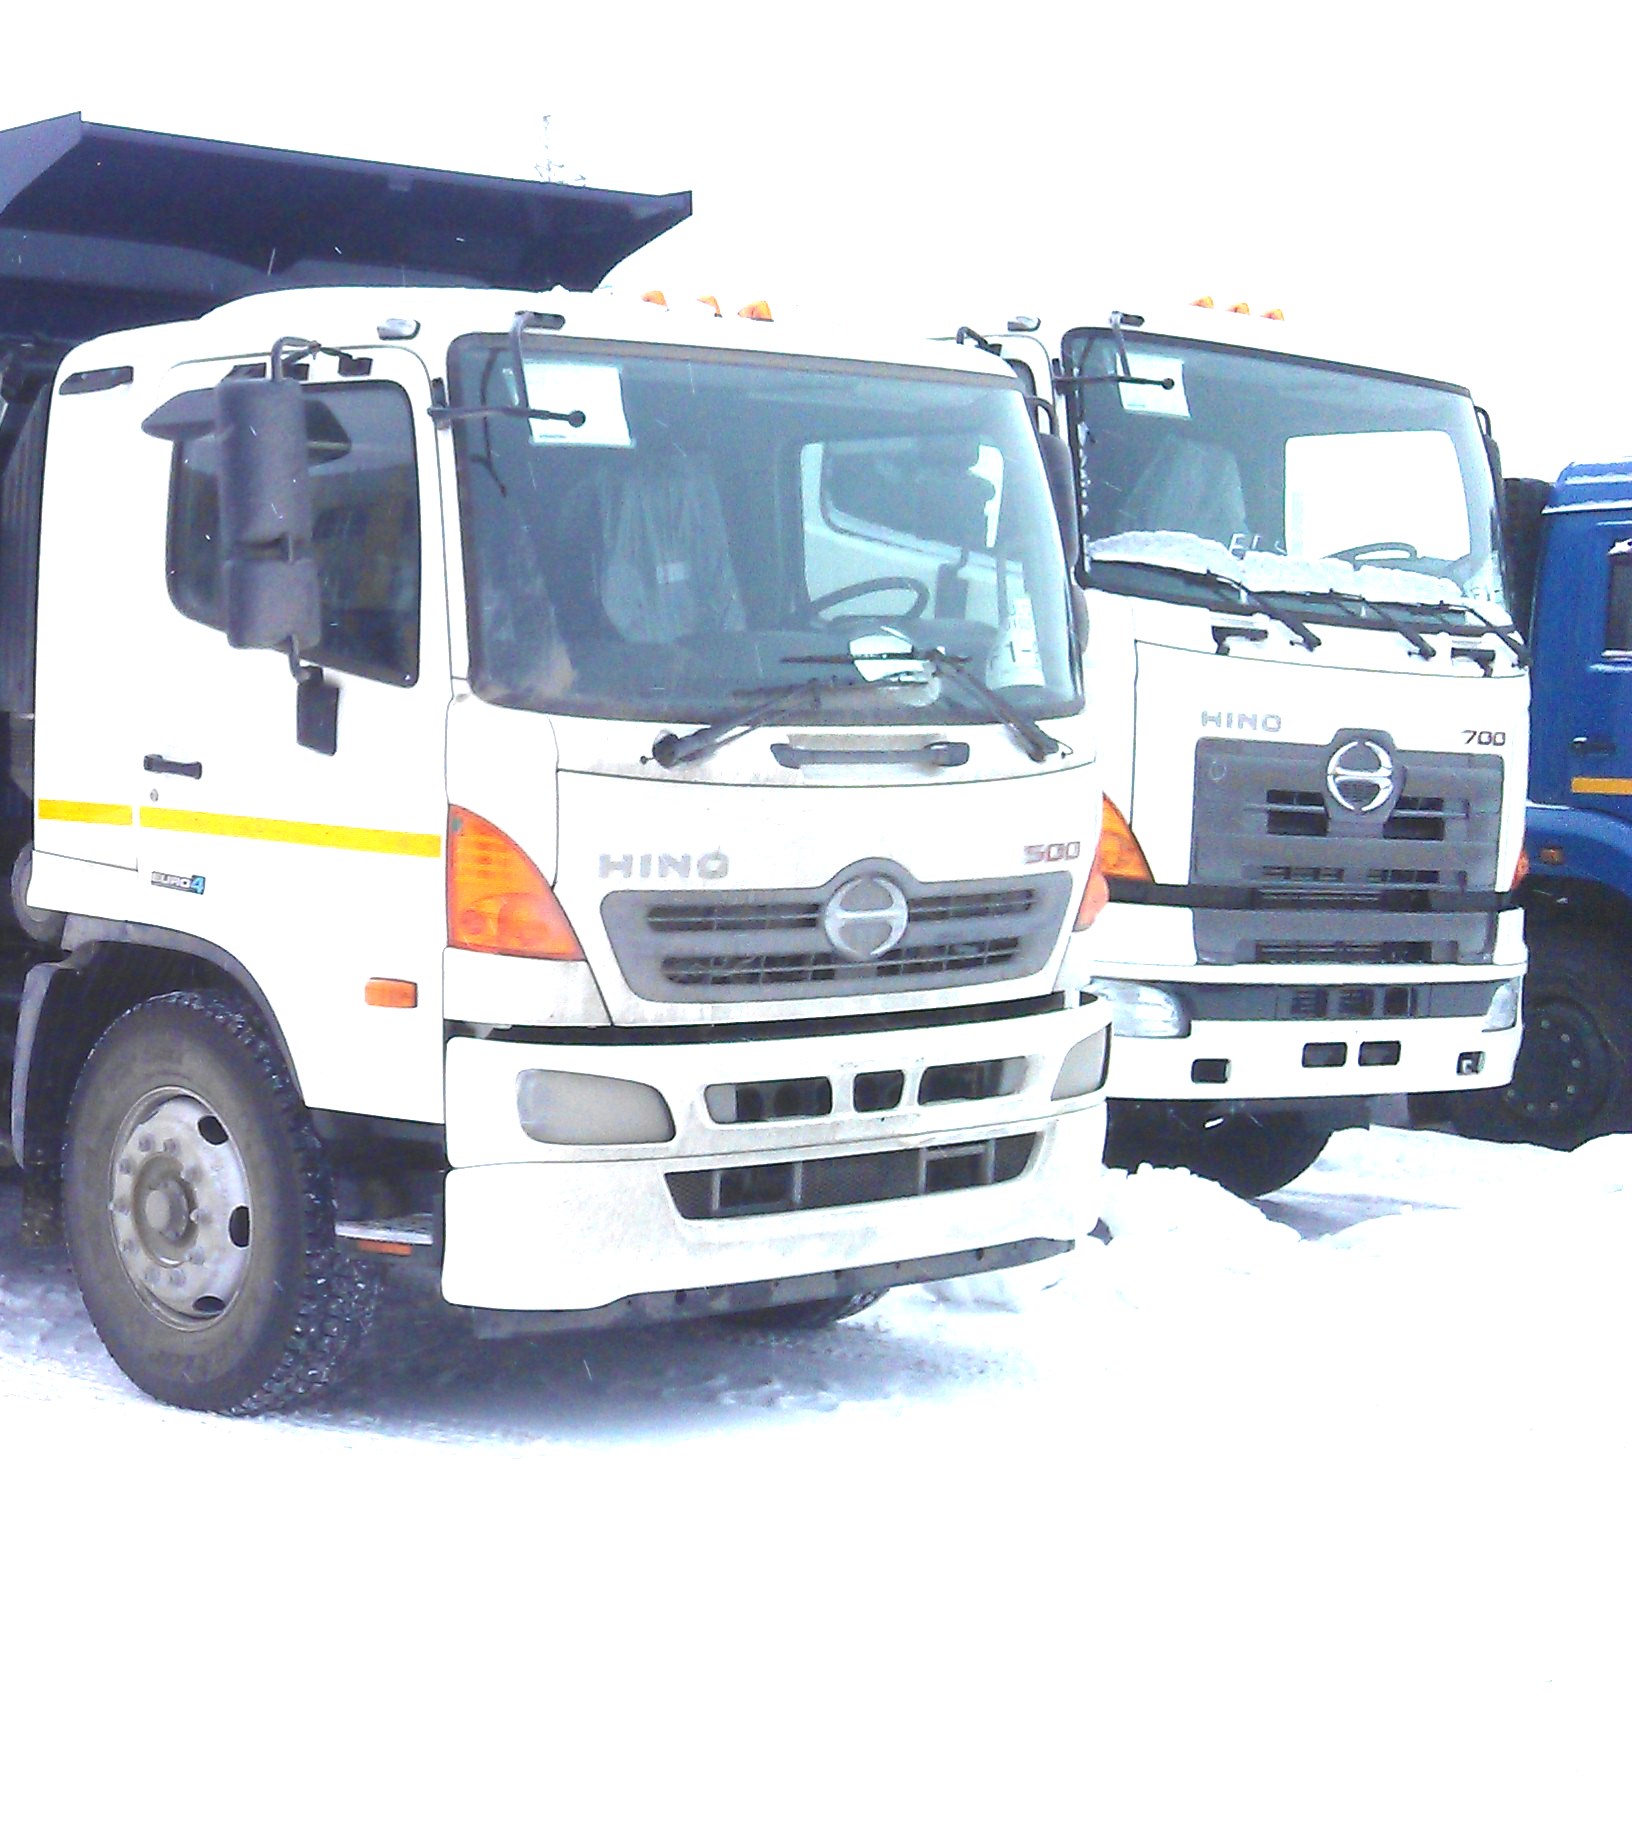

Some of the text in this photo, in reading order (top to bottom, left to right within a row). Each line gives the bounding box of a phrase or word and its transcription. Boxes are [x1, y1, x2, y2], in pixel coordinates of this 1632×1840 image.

[1201, 710, 1282, 732] HINO
[1461, 729, 1506, 746] 700
[1023, 841, 1081, 865] 500
[598, 851, 729, 880] HINO
